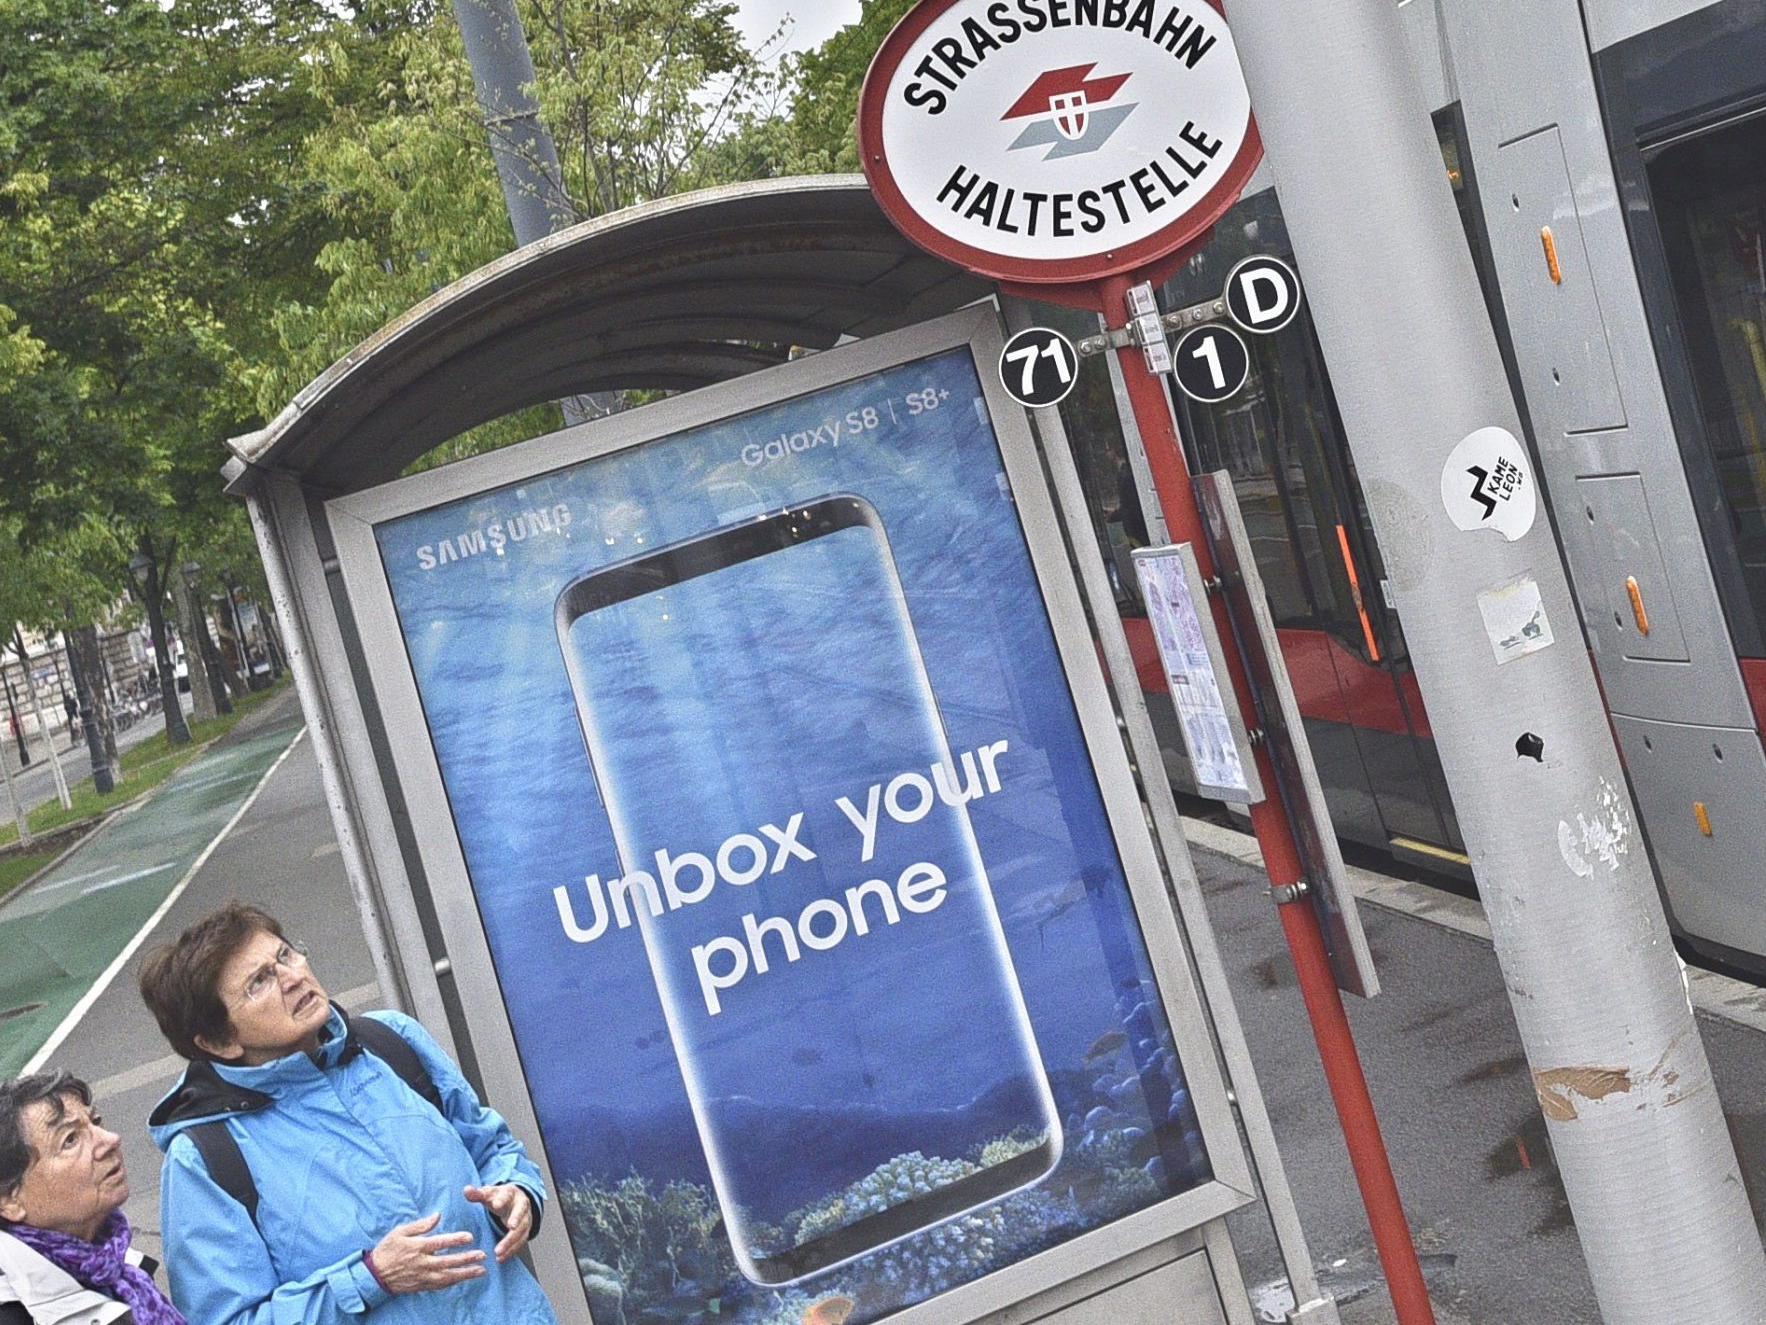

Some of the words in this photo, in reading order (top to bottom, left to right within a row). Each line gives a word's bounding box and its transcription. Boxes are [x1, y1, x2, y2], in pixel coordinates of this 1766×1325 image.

[936, 120, 1223, 238] HALTESTELLE
[1239, 267, 1289, 325] D
[1005, 338, 1073, 397] 71
[1192, 335, 1226, 390] 1
[740, 416, 842, 470] Galaxy
[845, 404, 880, 438] S8
[904, 384, 951, 417] S8+
[1487, 456, 1508, 495] KAME
[1499, 463, 1518, 501] LEON
[416, 501, 573, 572] SAMSUNG
[552, 812, 817, 945] Unbox
[834, 738, 1010, 861] your
[690, 860, 949, 1016] phone
